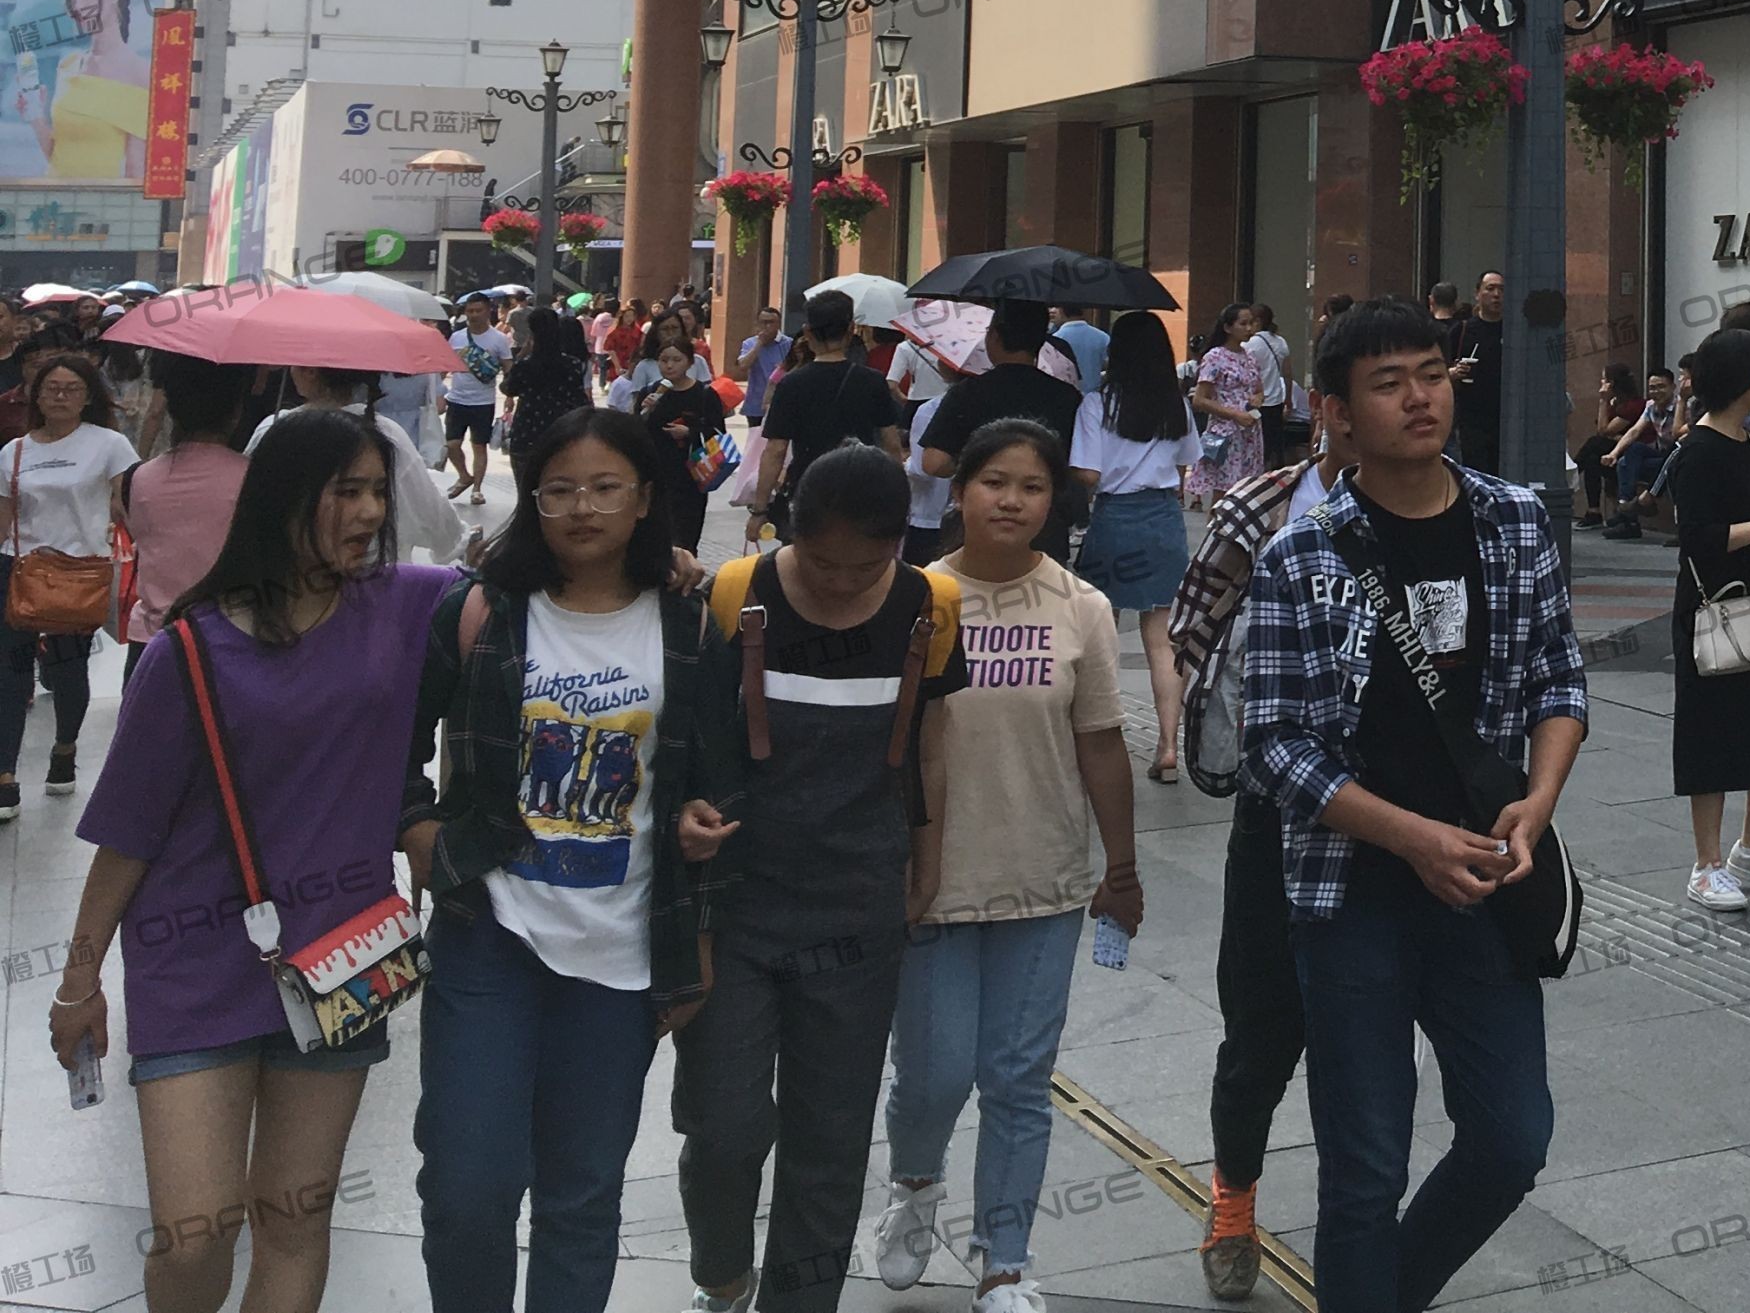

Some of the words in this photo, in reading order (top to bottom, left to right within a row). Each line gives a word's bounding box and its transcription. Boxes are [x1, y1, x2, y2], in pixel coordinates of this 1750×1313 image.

[376, 109, 429, 133] CLR
[868, 74, 929, 135] ZARA
[338, 167, 484, 188] 400-0777-188
[523, 665, 629, 704] alifornia
[561, 685, 650, 719] Raisins
